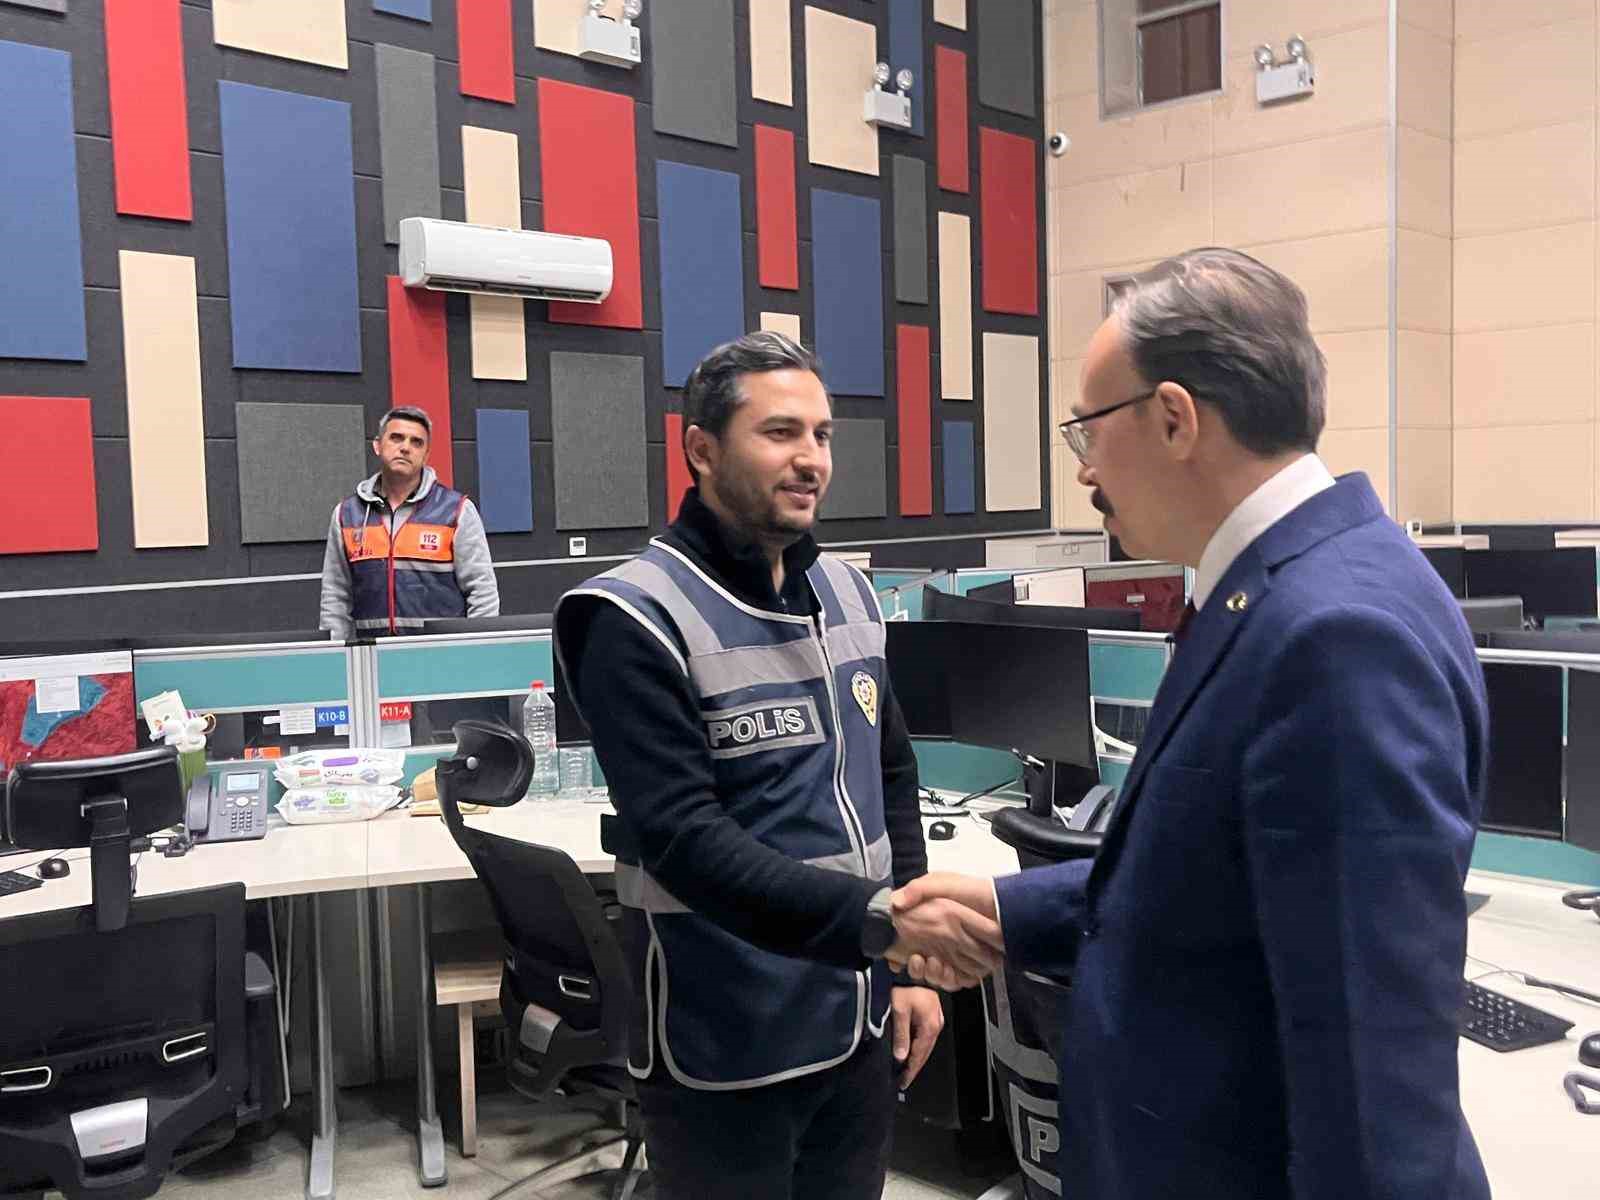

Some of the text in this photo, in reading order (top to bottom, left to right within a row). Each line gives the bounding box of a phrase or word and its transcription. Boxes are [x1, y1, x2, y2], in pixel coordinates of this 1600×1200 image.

[423, 534, 437, 544] 112
[319, 710, 346, 722] K10-B
[381, 706, 411, 717] K11-A
